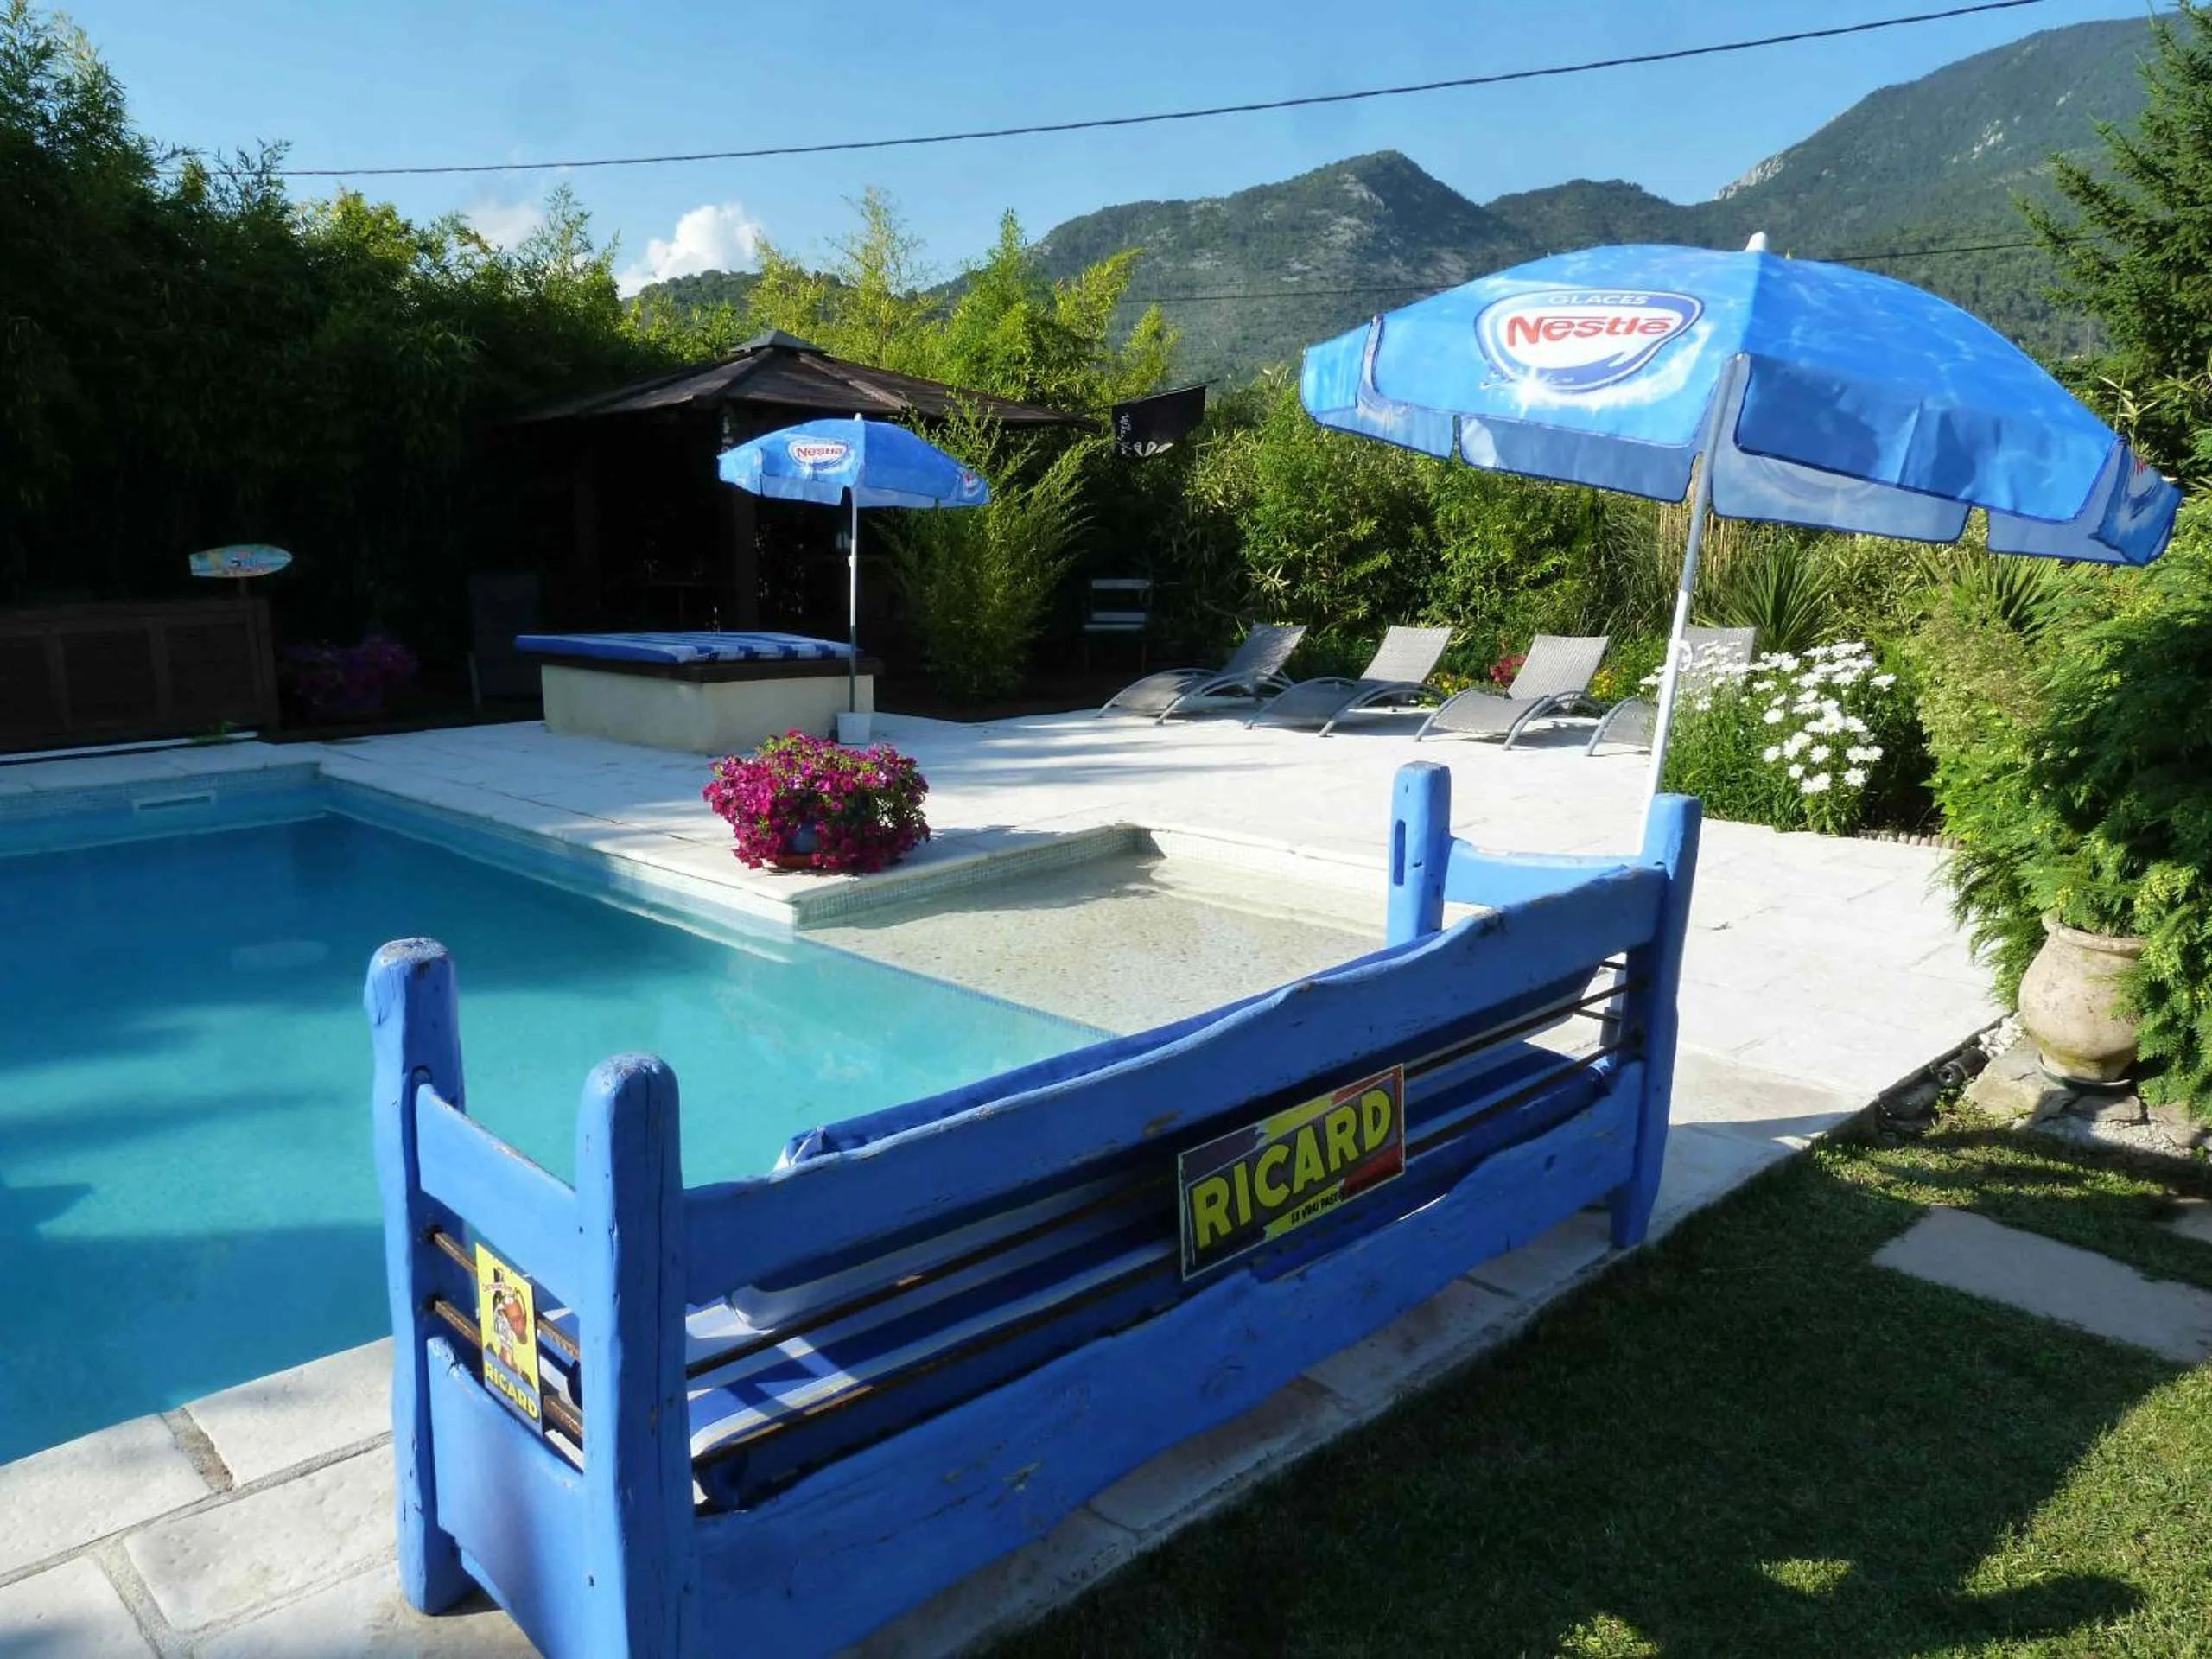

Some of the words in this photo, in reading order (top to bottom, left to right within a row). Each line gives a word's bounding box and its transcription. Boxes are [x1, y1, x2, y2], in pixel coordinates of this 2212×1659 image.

[1548, 294, 1649, 306] GLACES
[1192, 1089, 1391, 1249] RICARD
[484, 1359, 540, 1419] RICARD
